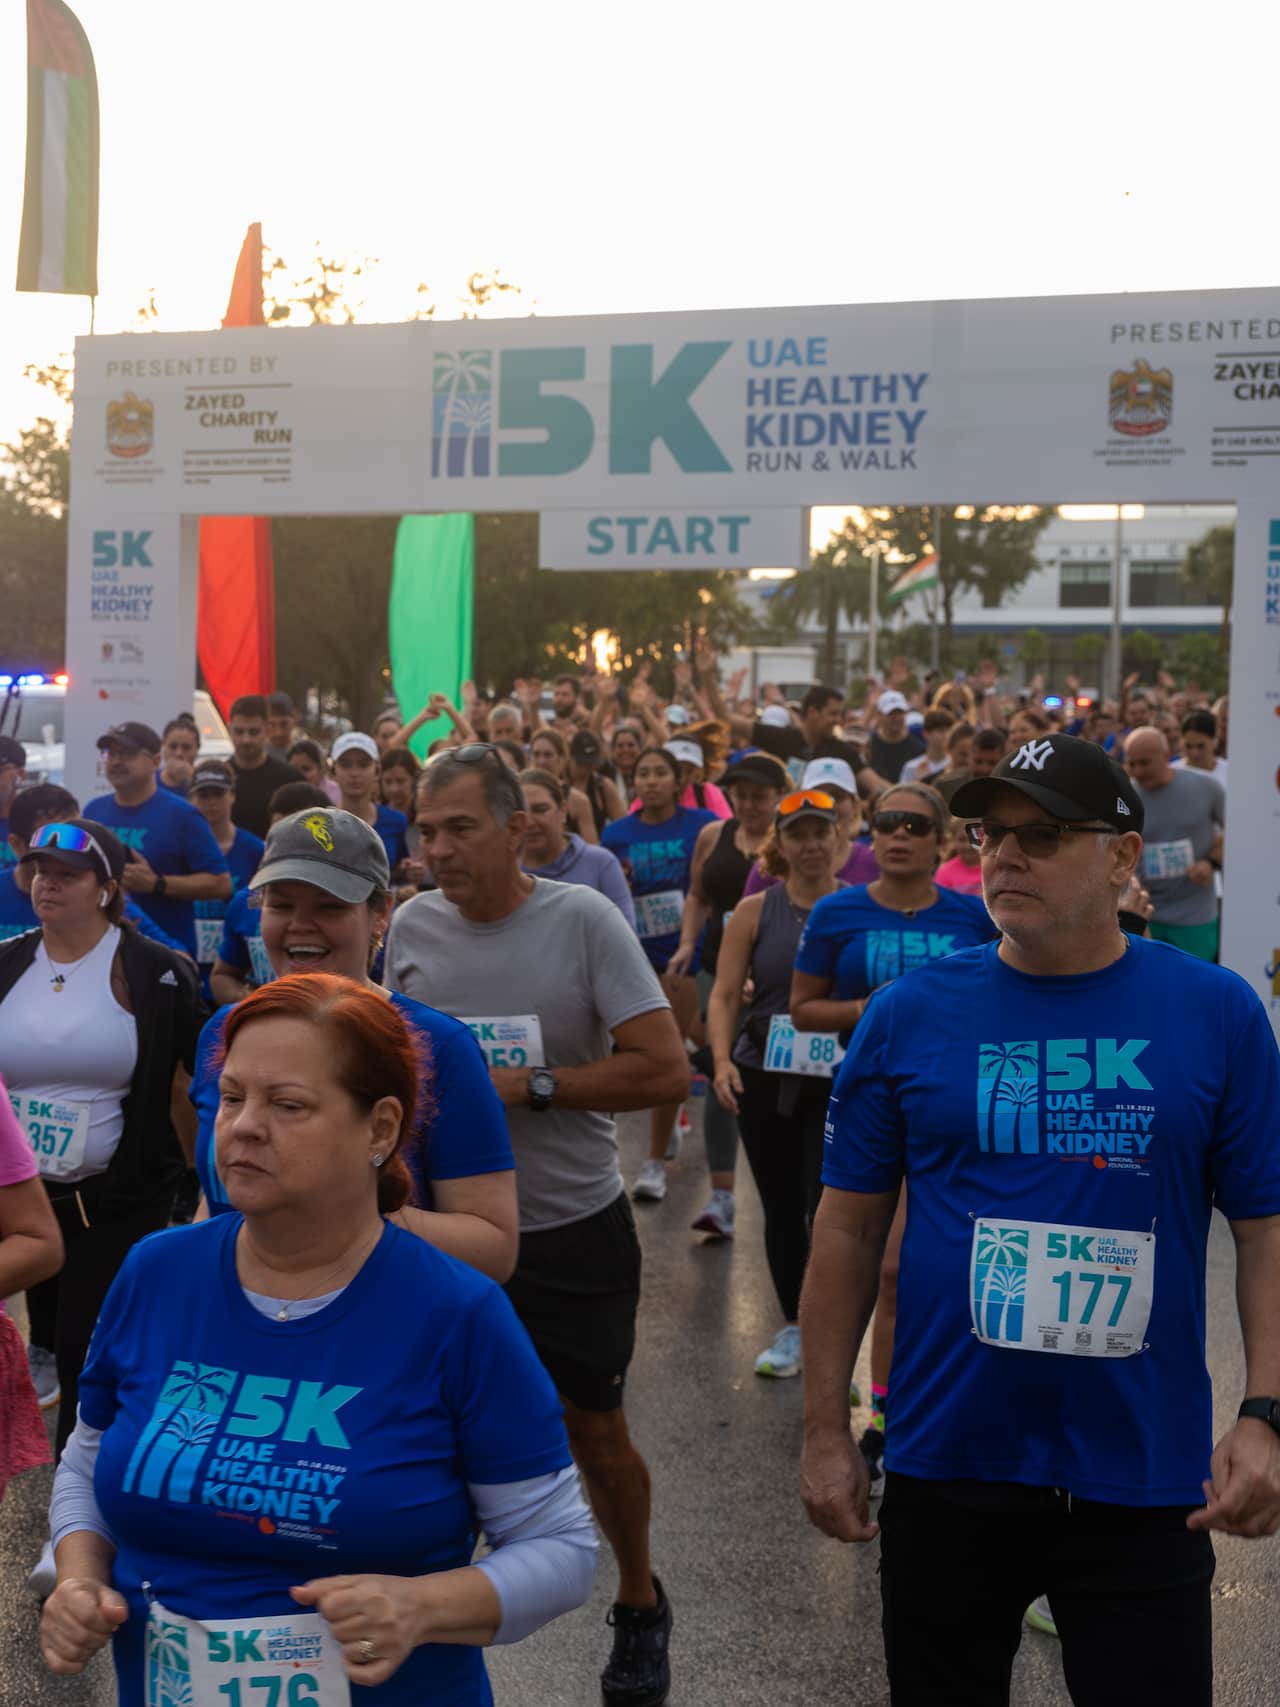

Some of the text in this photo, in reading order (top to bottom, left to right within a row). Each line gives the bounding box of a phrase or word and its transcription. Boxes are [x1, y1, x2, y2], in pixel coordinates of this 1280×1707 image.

[1110, 318, 1280, 344] PRESENTED
[746, 337, 828, 368] UAE
[106, 356, 279, 378] PRESENTED BY
[184, 393, 246, 411] ZAYED
[744, 373, 930, 408] HEALTHY
[200, 410, 279, 428] CHARITY
[497, 341, 734, 477] 5K
[254, 428, 293, 444] RUN
[744, 410, 928, 448] KIDNEY
[746, 449, 918, 473] RUN & WALK
[586, 515, 751, 555] START
[92, 530, 154, 567] 5K
[92, 584, 154, 597] HEALTHY
[91, 599, 153, 613] KIDNEY
[902, 930, 956, 957] 5K
[809, 1037, 836, 1063] 88
[1046, 1039, 1155, 1091] 5K
[28, 1101, 53, 1118] 5K
[1046, 1093, 1095, 1111] UAE
[1046, 1112, 1156, 1132] HEALTHY
[28, 1121, 74, 1157] 357
[1046, 1132, 1154, 1155] KIDNEY
[1046, 1232, 1097, 1263] 5K
[1097, 1246, 1138, 1256] HEALTHY
[1098, 1236, 1118, 1247] UAE
[1097, 1255, 1138, 1266] KIDNEY
[1052, 1270, 1133, 1327] 177
[223, 1374, 365, 1450] 5K
[216, 1438, 277, 1462] UAE
[205, 1458, 345, 1496] HEALTHY
[201, 1480, 342, 1525] KIDNEY
[207, 1629, 266, 1663] 5K
[267, 1635, 322, 1649] HEALTHY
[267, 1646, 323, 1661] KIDNEY
